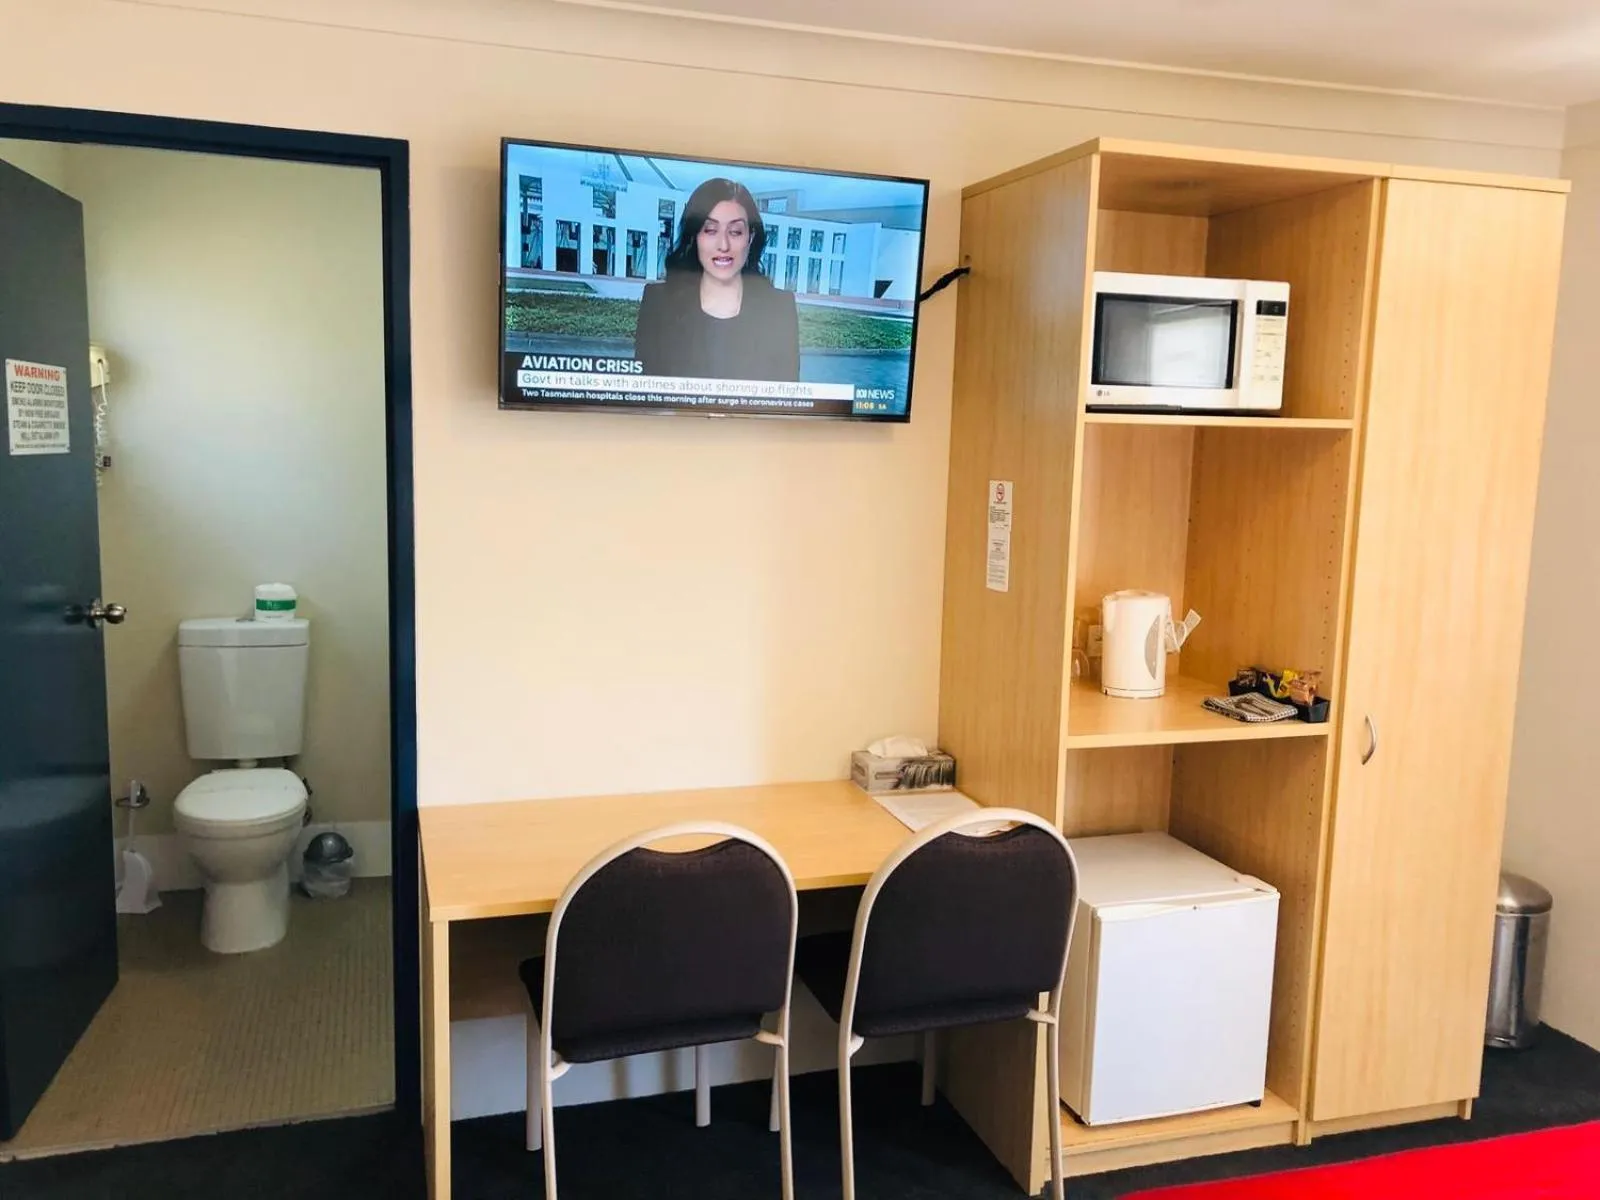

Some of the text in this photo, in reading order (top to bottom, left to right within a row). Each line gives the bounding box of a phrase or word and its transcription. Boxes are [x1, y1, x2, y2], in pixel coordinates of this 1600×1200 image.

[14, 364, 60, 381] WARNING
[522, 355, 643, 374] AVIATION CRISIS
[10, 380, 26, 393] KEEP
[27, 382, 43, 395] DOOR
[522, 373, 813, 396] Govt in talks with airlines about shoring up flights
[522, 389, 539, 397] Two
[540, 389, 585, 399] Tasmanian
[586, 391, 623, 401] hospitals
[624, 393, 645, 401] close
[647, 394, 662, 402] this
[663, 395, 696, 405] morning
[698, 395, 716, 404] after
[718, 398, 739, 406] surge
[749, 398, 792, 407] coronavirus
[868, 389, 895, 400] NEWS
